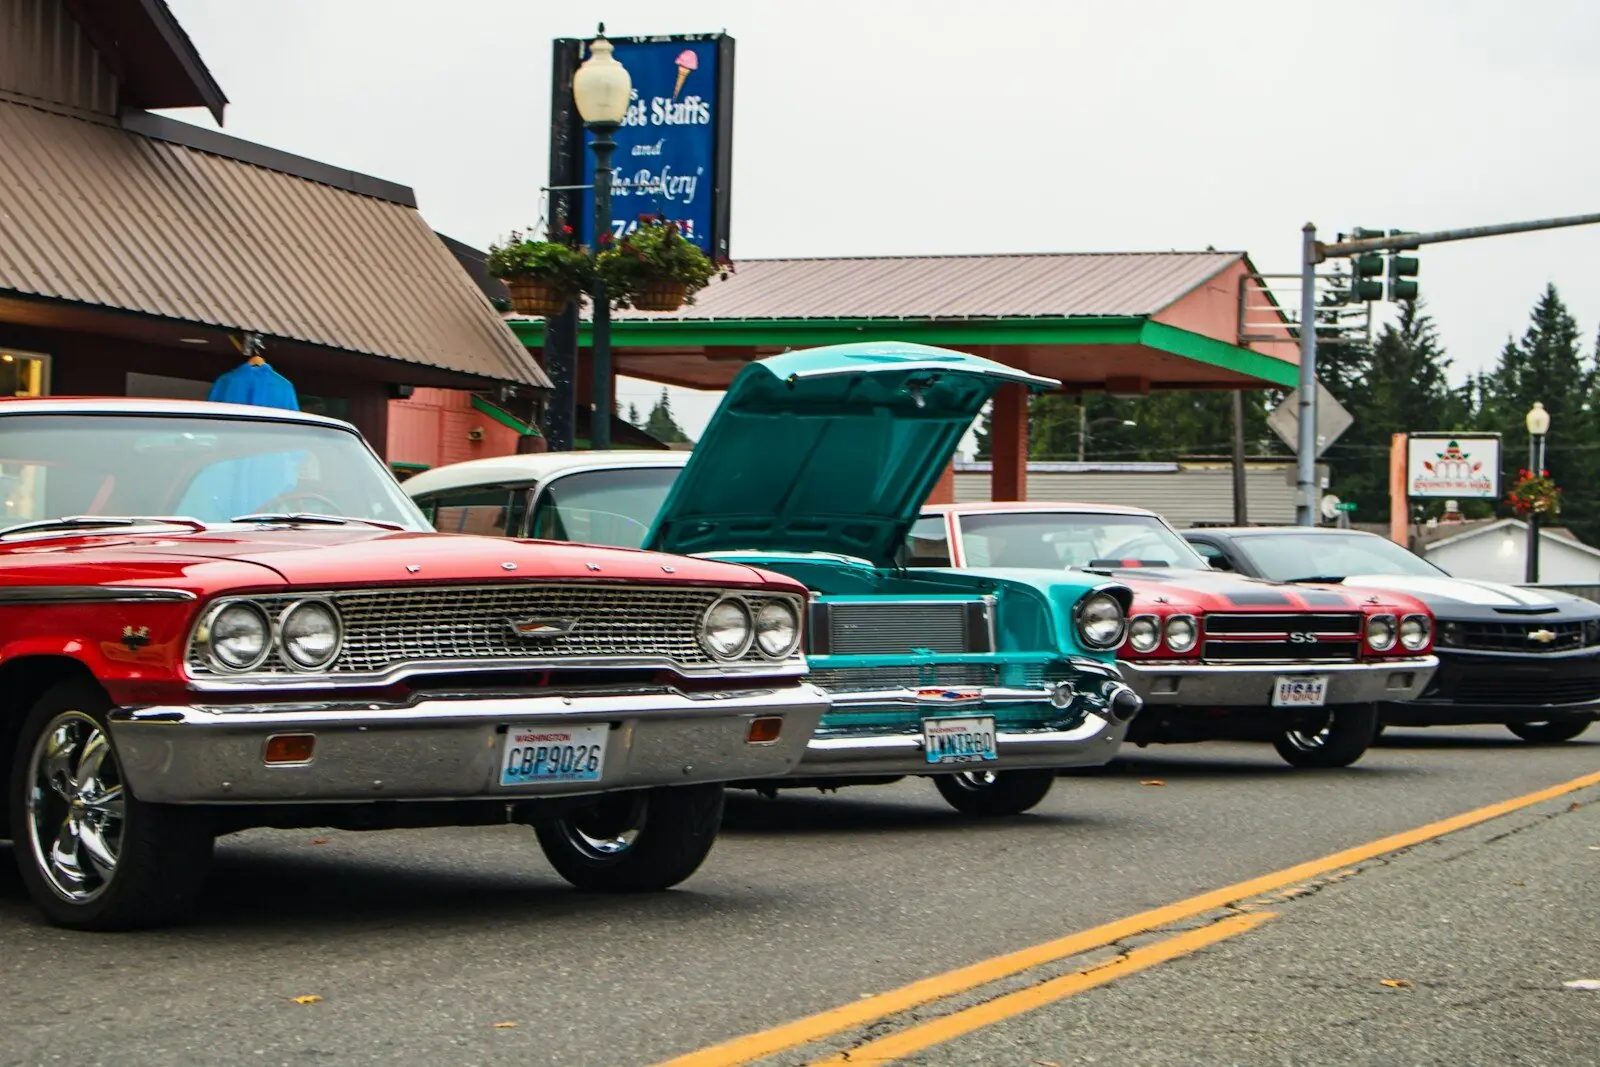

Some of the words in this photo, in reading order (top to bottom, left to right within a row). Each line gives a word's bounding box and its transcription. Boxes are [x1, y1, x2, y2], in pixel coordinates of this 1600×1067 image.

[631, 138, 666, 156] and
[610, 166, 631, 196] he
[1290, 632, 1318, 643] SS
[515, 733, 572, 742] WASHINGTON
[507, 744, 601, 776] CBP9026
